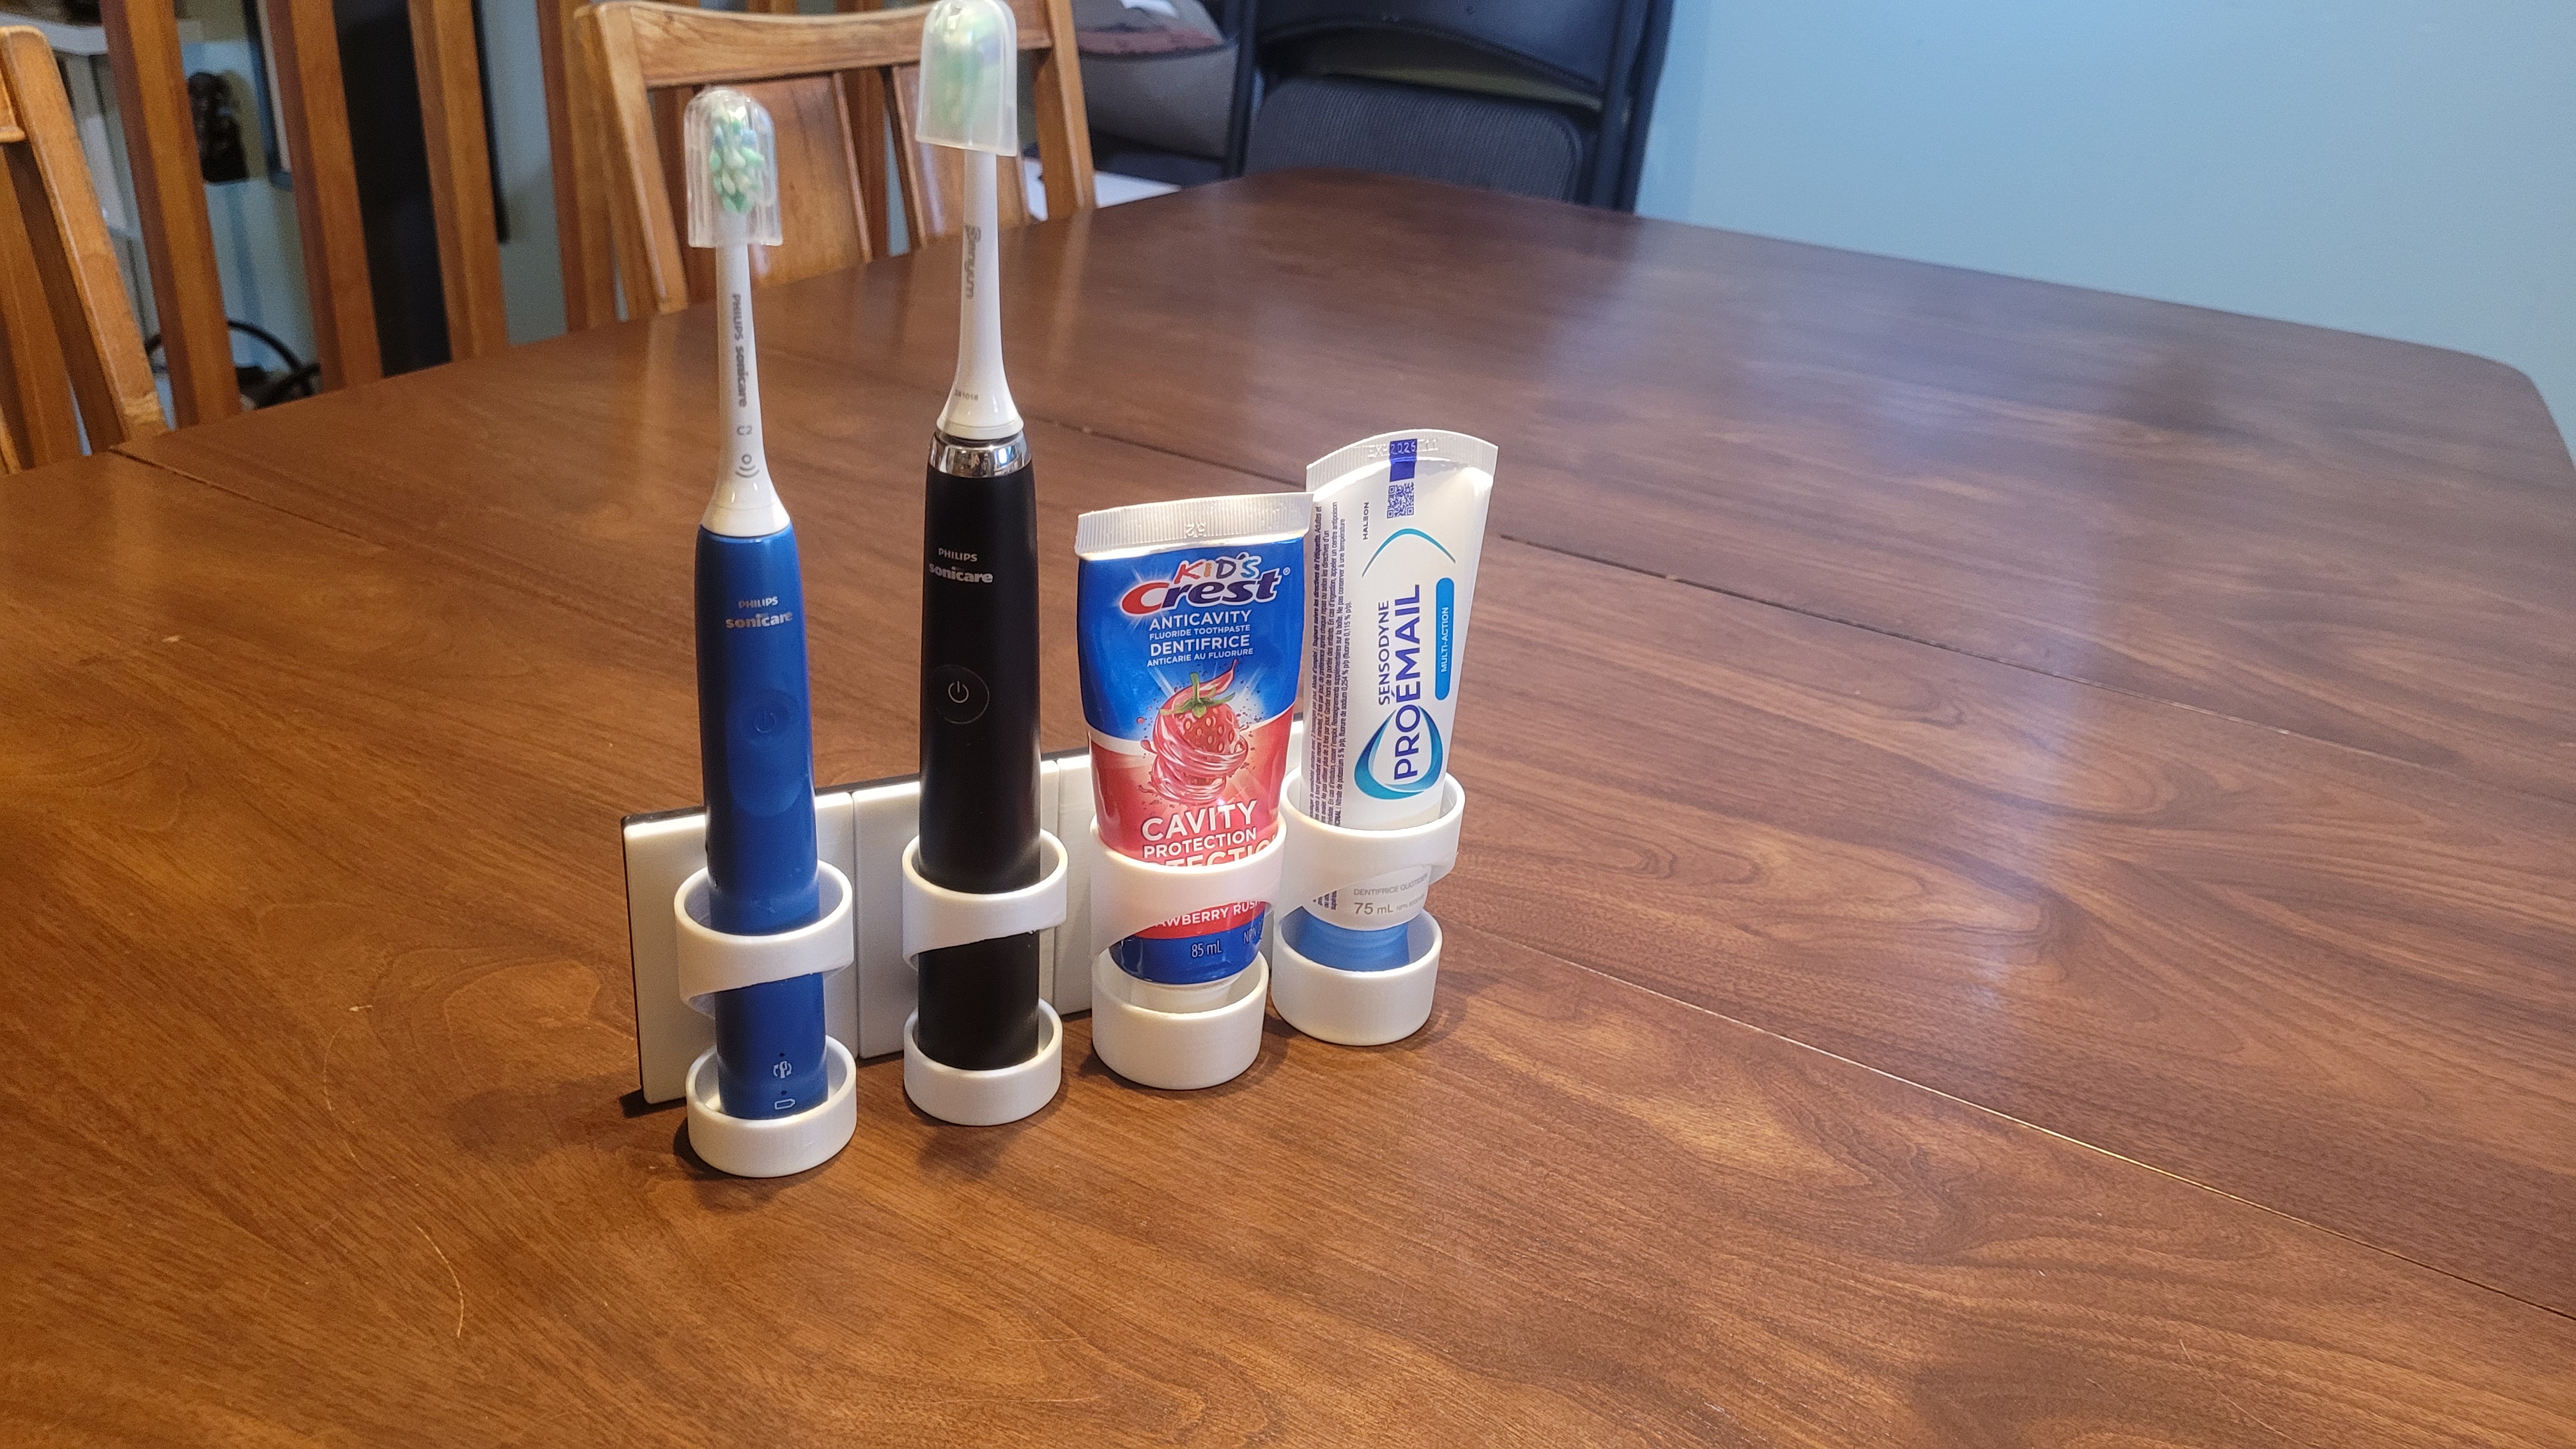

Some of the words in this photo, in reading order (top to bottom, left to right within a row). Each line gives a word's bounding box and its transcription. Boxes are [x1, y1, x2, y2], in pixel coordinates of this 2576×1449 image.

[732, 293, 744, 341] PHILIPS
[737, 425, 753, 436] C2
[938, 548, 977, 562] PHILIPS
[929, 564, 993, 583] sonicare
[1174, 553, 1259, 584] KID'S
[739, 596, 778, 608] PHILIPS
[1122, 570, 1279, 615] Crest
[726, 612, 793, 629] sonicare
[1149, 610, 1252, 631] ANTICAVITY
[1149, 629, 1192, 640] FLUORIDE
[1194, 624, 1251, 635] TOOTHPASTE
[1440, 607, 1449, 672] MULTI-ACTION
[1150, 634, 1250, 656] DENTIFRICE
[1378, 600, 1390, 705] SENSODYNE
[1147, 654, 1192, 668] ANTICARIE
[1208, 648, 1254, 659] FLUORURE
[1391, 584, 1421, 780] PROÉMAIL
[1141, 800, 1257, 841] CAVITY
[1144, 827, 1257, 859] PROTECTION
[1353, 885, 1399, 896] DENTIFRICE
[1354, 902, 1374, 915] 75
[1377, 904, 1394, 914] mL
[1191, 942, 1204, 958] 85
[1206, 939, 1222, 955] mL
